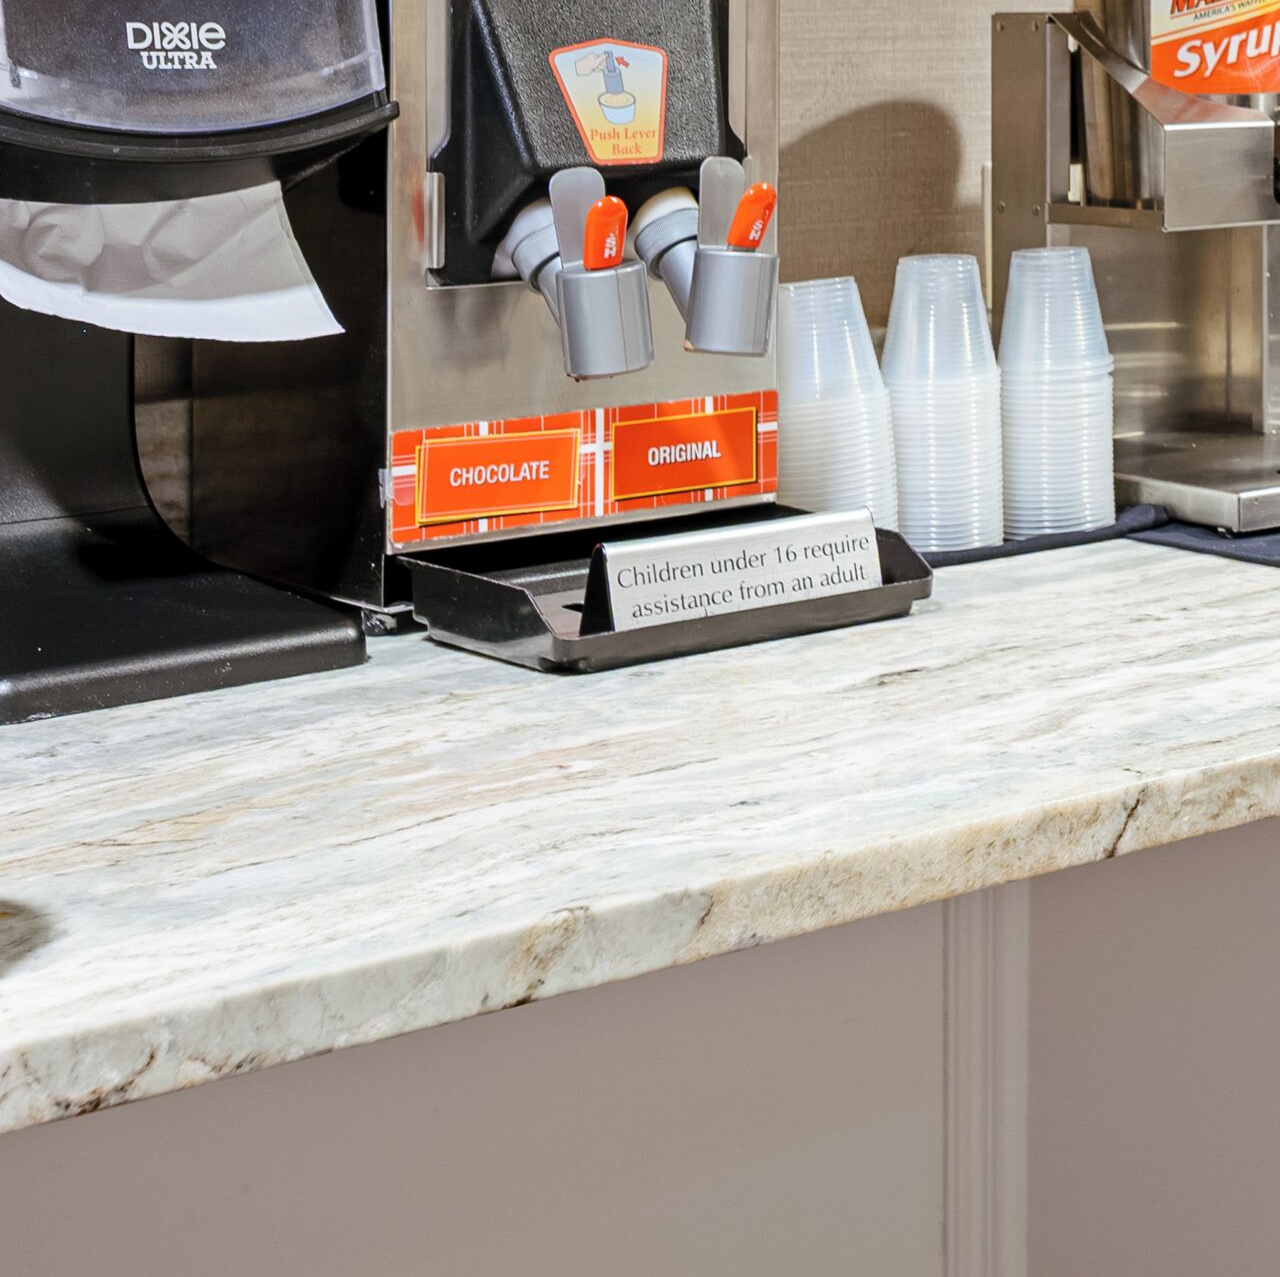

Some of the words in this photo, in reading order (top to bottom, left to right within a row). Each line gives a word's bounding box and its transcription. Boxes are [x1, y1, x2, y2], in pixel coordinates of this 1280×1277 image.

[1192, 0, 1237, 22] AMERICA'S
[140, 51, 217, 69] ULTRA
[590, 127, 620, 141] Push
[624, 127, 657, 140] Lever
[612, 143, 642, 156] Back
[648, 440, 721, 467] ORIGINAL
[450, 460, 550, 487] CHOCOLATE
[617, 560, 704, 589] Children
[711, 550, 768, 574] under
[775, 545, 797, 564] 16
[803, 534, 870, 562] require
[632, 588, 734, 619] assistance
[739, 581, 786, 601] from
[791, 575, 814, 593] an
[820, 563, 866, 588] adult
